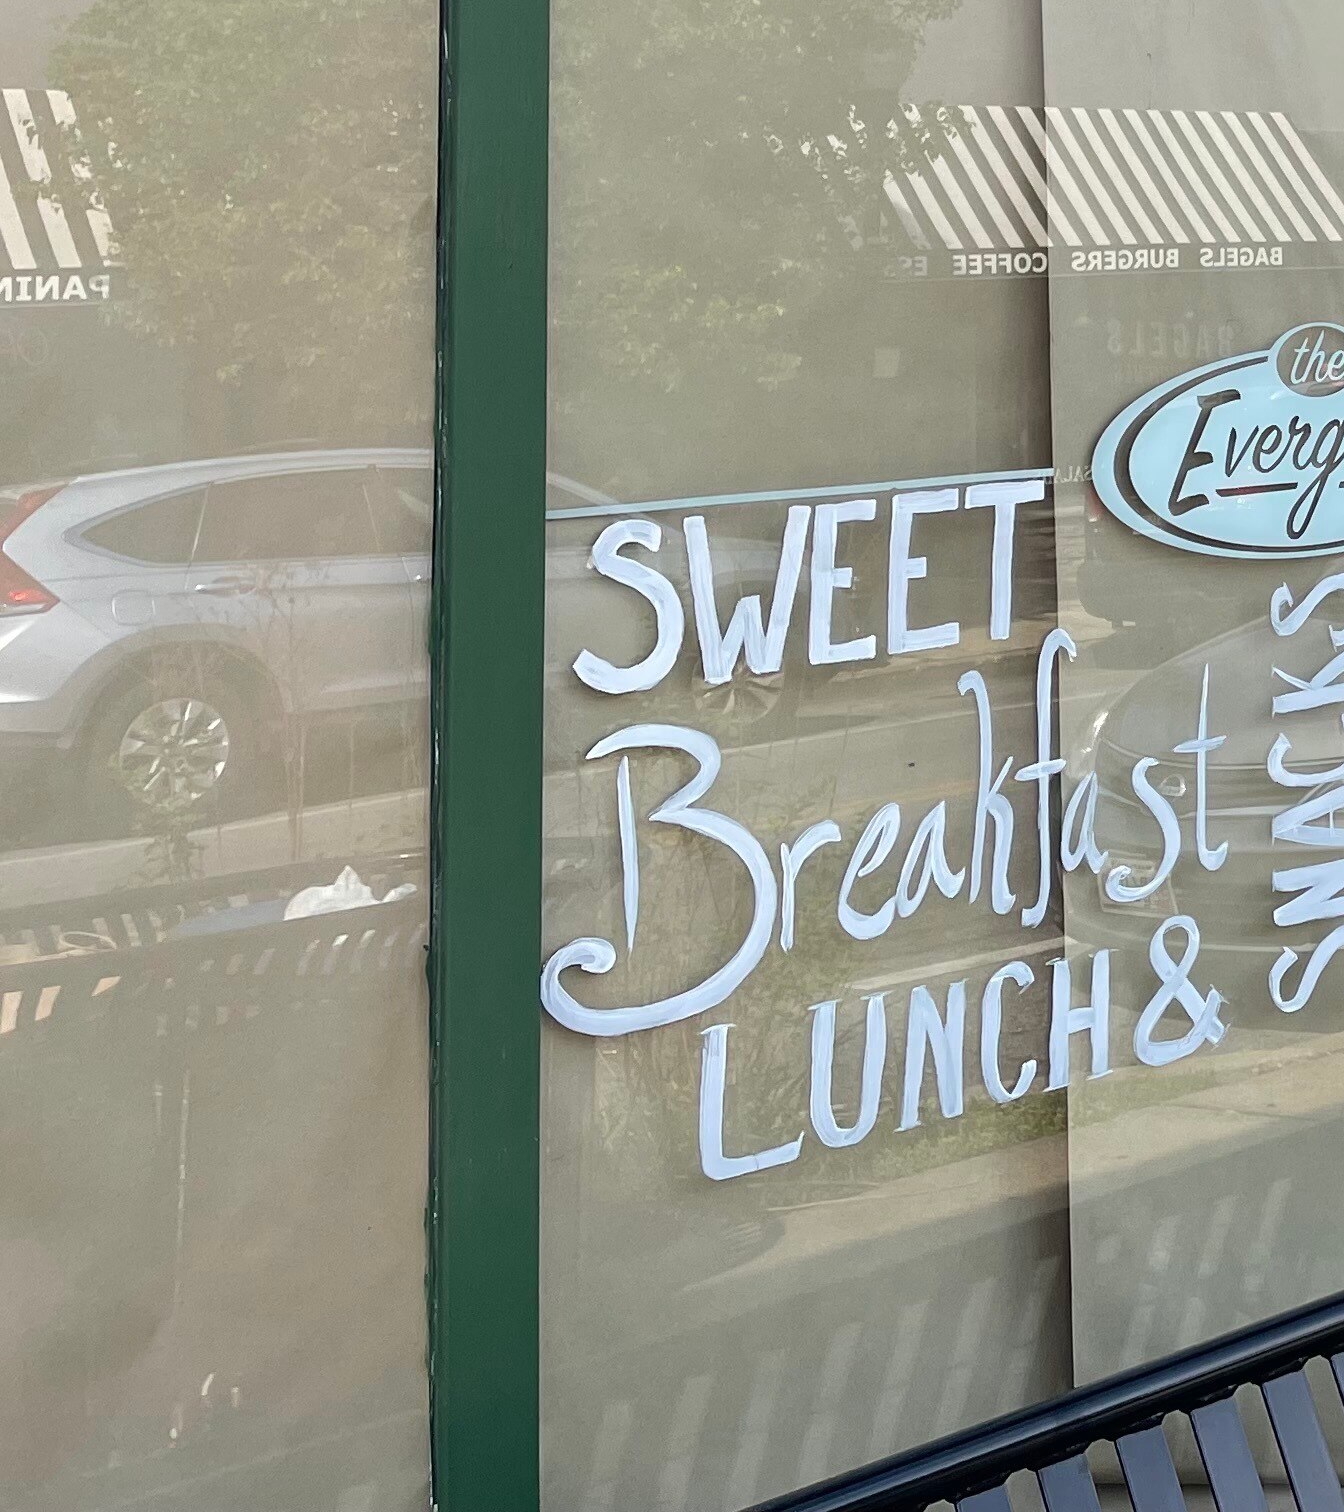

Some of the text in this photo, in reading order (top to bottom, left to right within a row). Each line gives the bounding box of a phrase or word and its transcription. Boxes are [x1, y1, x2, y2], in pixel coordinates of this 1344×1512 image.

[572, 480, 1047, 696] SWEET
[540, 628, 1229, 1037] Breakfast
[698, 914, 1230, 1181] LUNCH &
